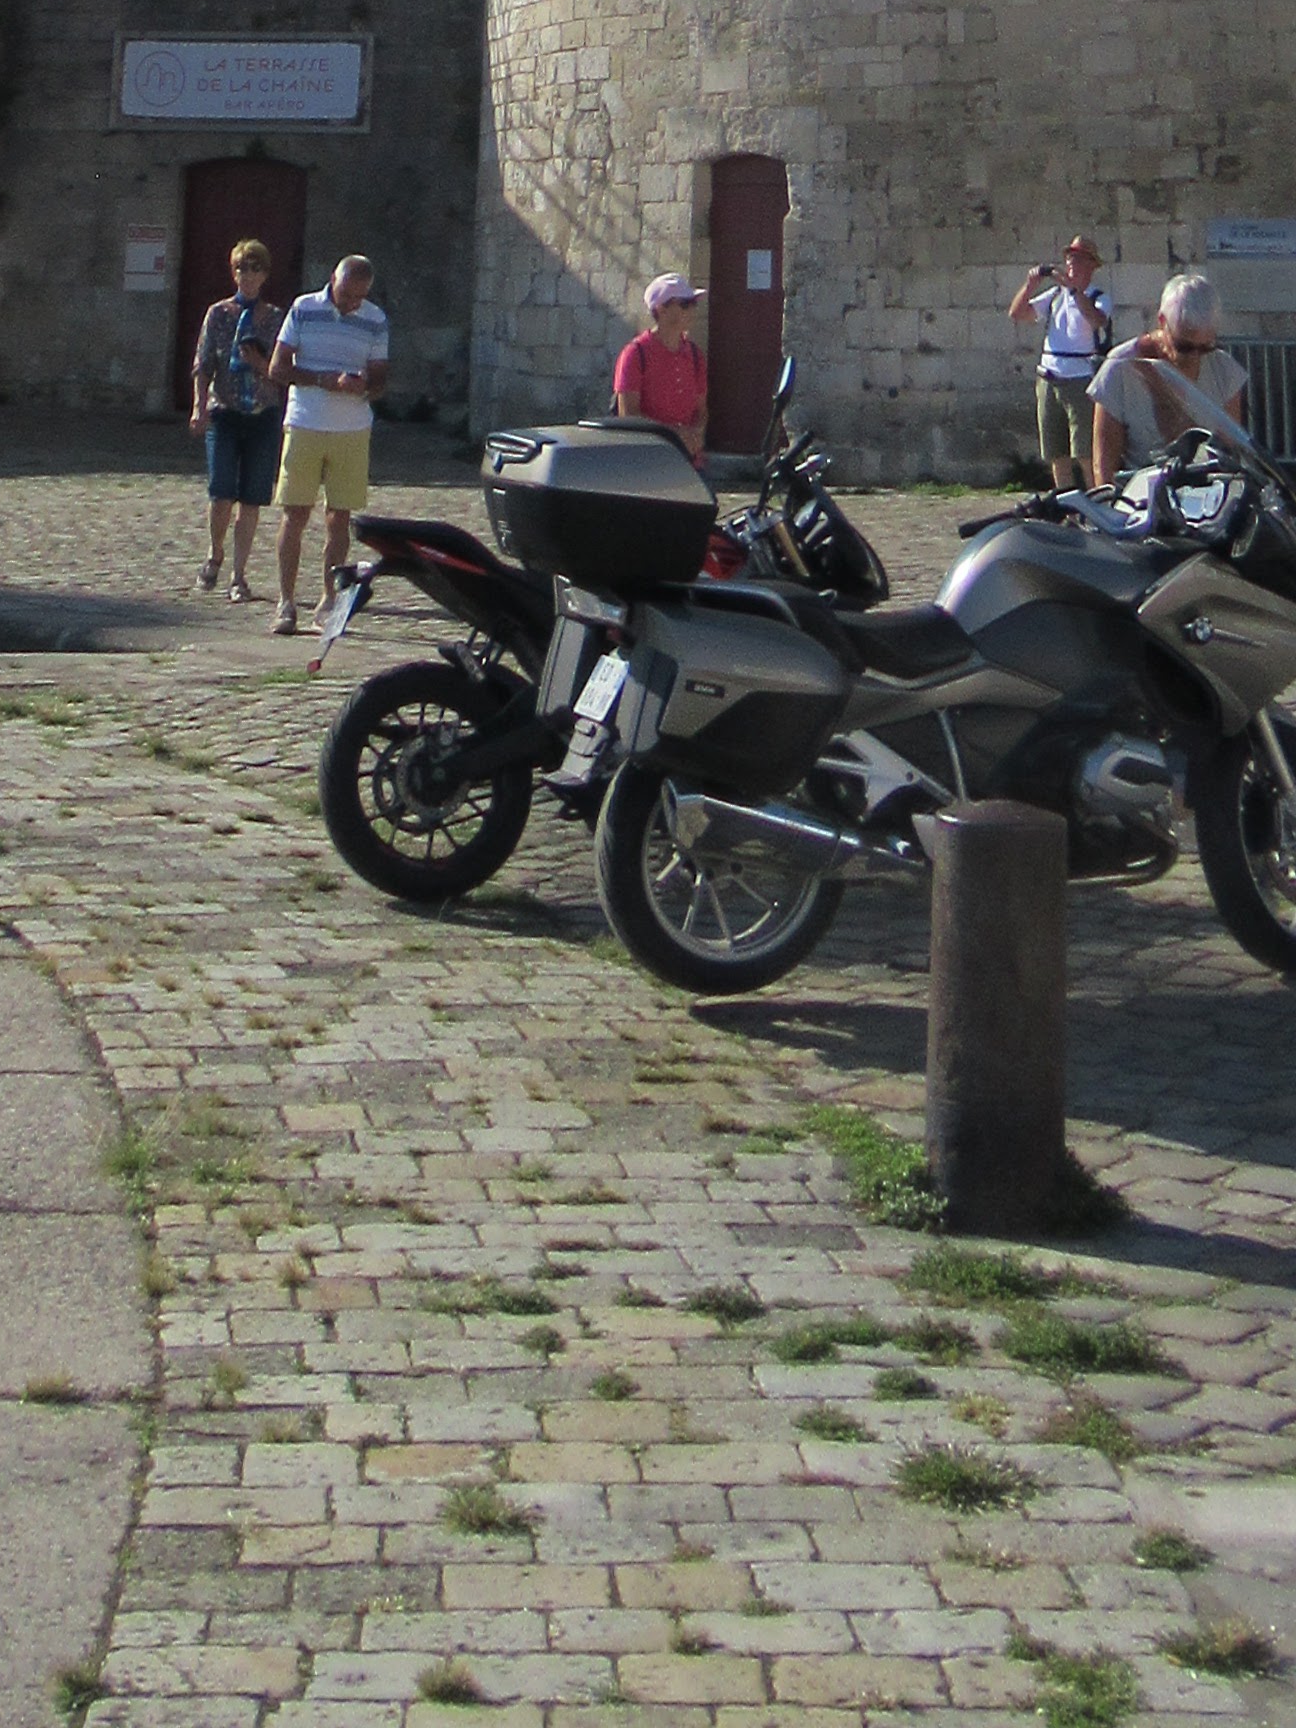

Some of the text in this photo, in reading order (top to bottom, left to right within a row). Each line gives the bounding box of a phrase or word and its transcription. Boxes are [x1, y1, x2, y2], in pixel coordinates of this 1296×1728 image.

[204, 57, 331, 73] LA TERRASSE
[196, 78, 222, 93] DE
[229, 78, 251, 93] LA
[223, 99, 253, 111] BAR
